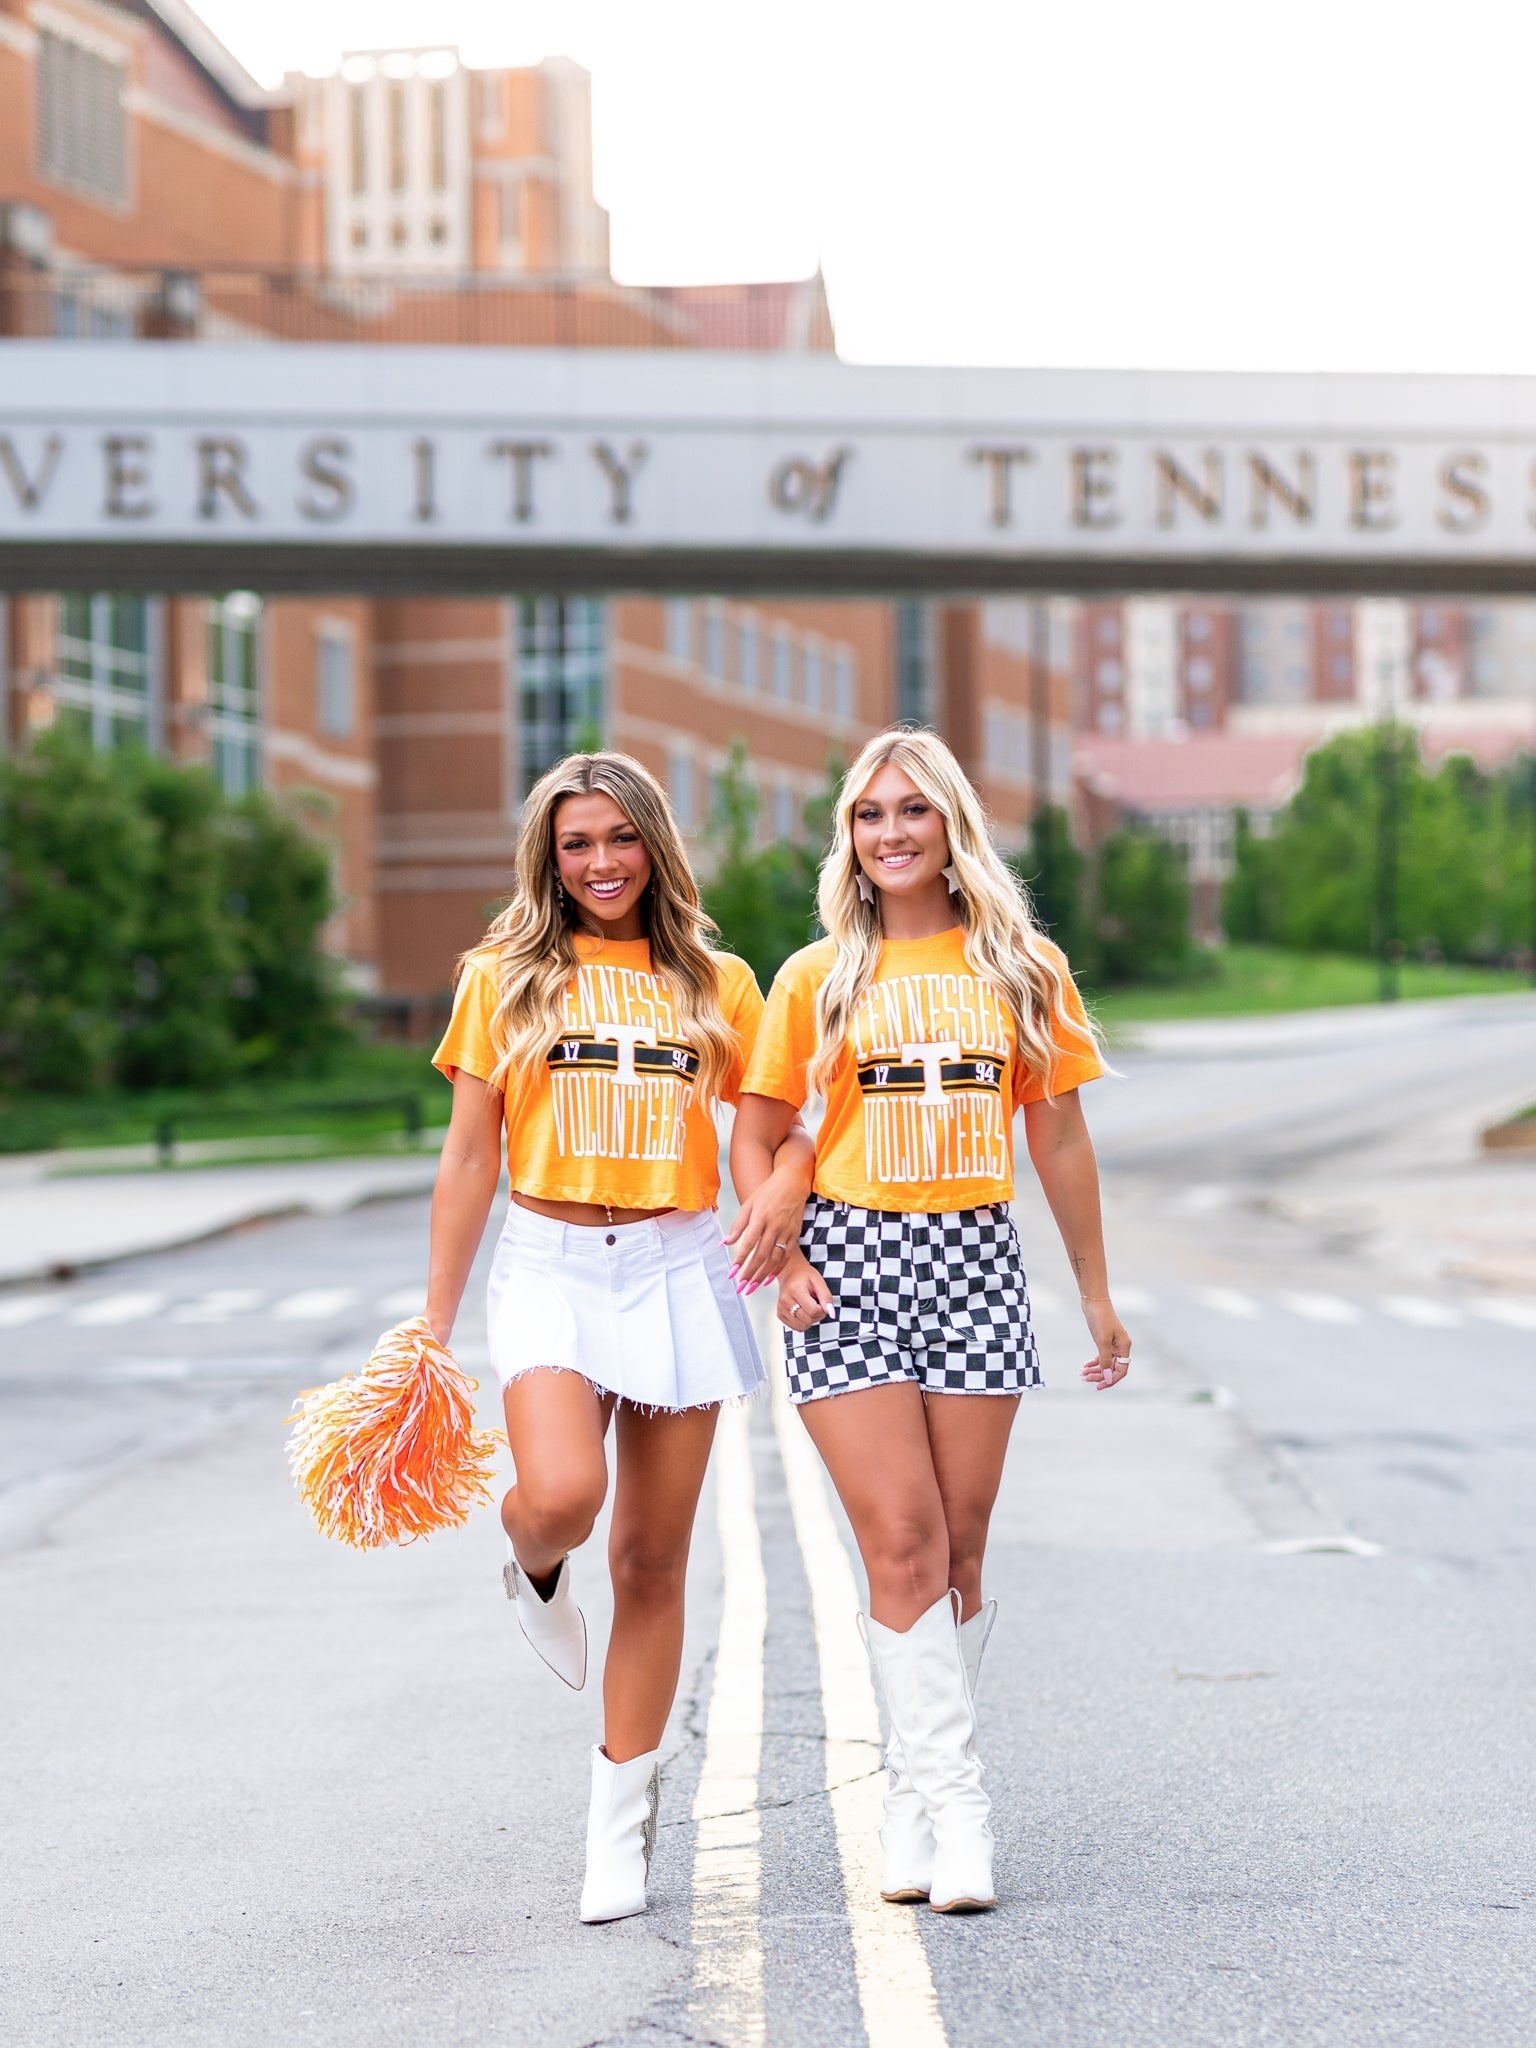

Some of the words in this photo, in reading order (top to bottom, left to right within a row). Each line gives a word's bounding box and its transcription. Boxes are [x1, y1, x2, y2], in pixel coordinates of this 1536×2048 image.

[0, 433, 649, 525] VERSITY
[766, 443, 858, 526] of
[966, 446, 1536, 535] TENNES
[562, 964, 689, 1040] ENNESS
[562, 1041, 580, 1061] 17
[594, 1022, 657, 1086] T
[672, 1050, 688, 1072] 94
[873, 1065, 889, 1086] 17
[900, 1040, 962, 1106] T
[975, 1061, 995, 1083] 94
[862, 1092, 1006, 1183] VOLUNTEERS
